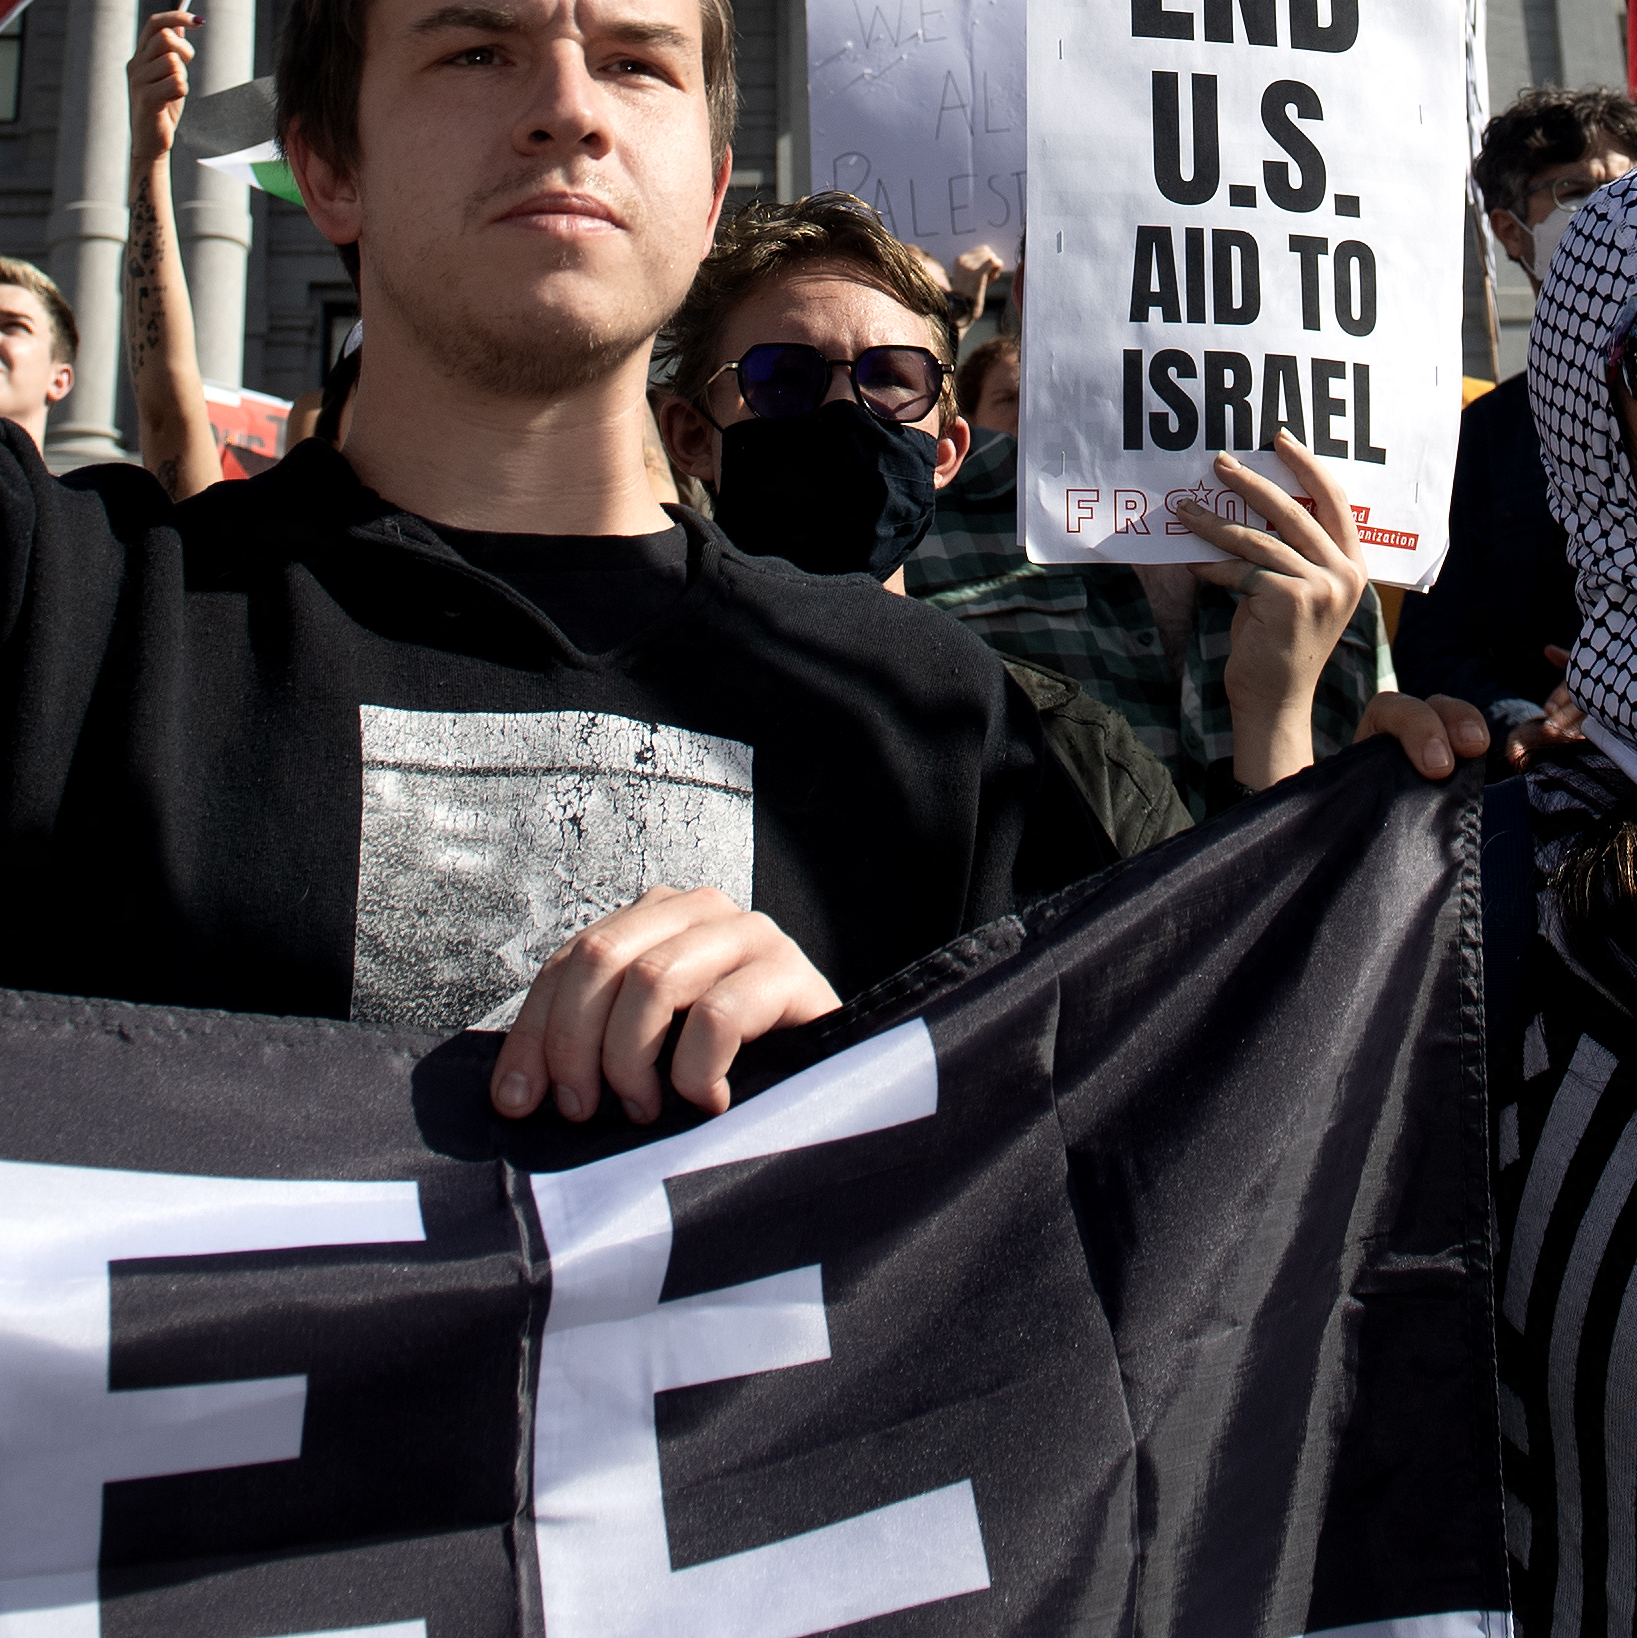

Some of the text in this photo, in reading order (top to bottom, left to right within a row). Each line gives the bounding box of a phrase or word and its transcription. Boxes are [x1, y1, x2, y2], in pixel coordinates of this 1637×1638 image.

[1151, 70, 1360, 218] U.S.
[1129, 225, 1378, 337] AID TO
[1123, 348, 1387, 465] ISRAEL
[1358, 528, 1415, 547] anization
